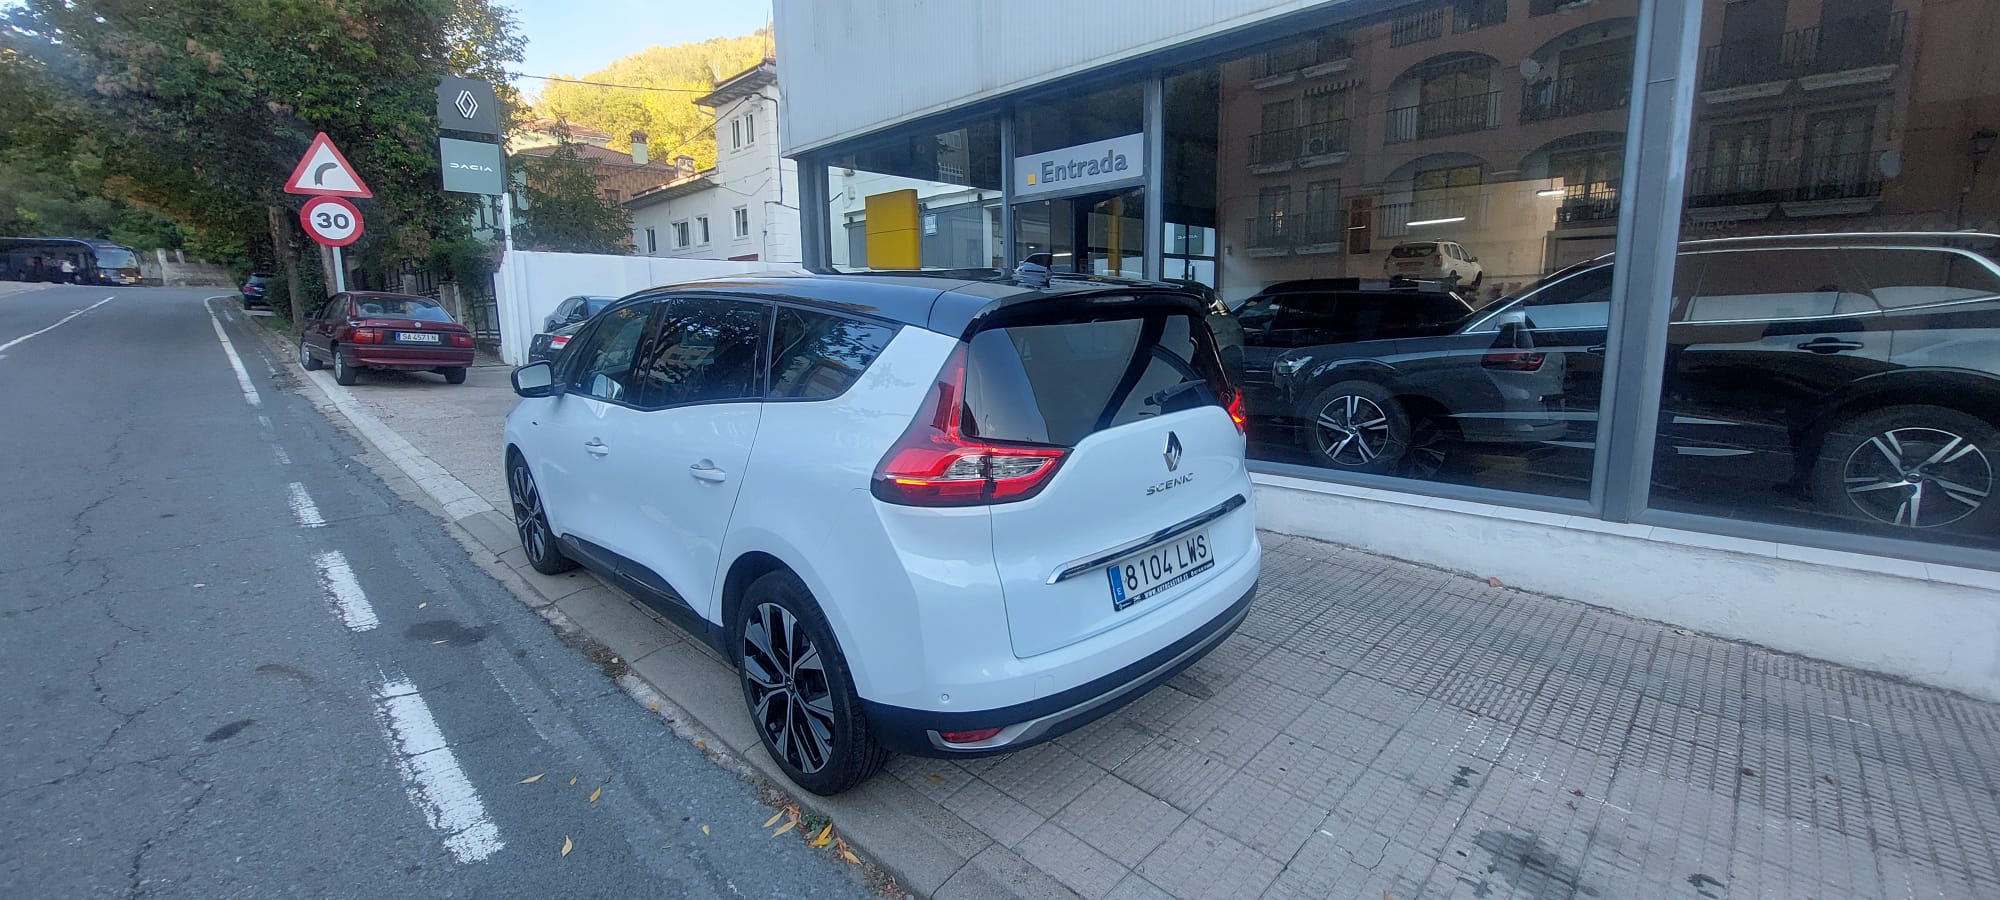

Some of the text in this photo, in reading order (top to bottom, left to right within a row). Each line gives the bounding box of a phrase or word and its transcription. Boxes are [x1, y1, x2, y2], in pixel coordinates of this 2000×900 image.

[449, 162, 493, 172] DACIA
[1041, 149, 1129, 184] Entrada
[316, 212, 350, 230] 30
[1146, 472, 1194, 496] SCENIC
[1117, 587, 1122, 596] E
[1125, 549, 1173, 591] 8104
[1176, 534, 1207, 569] LWS
